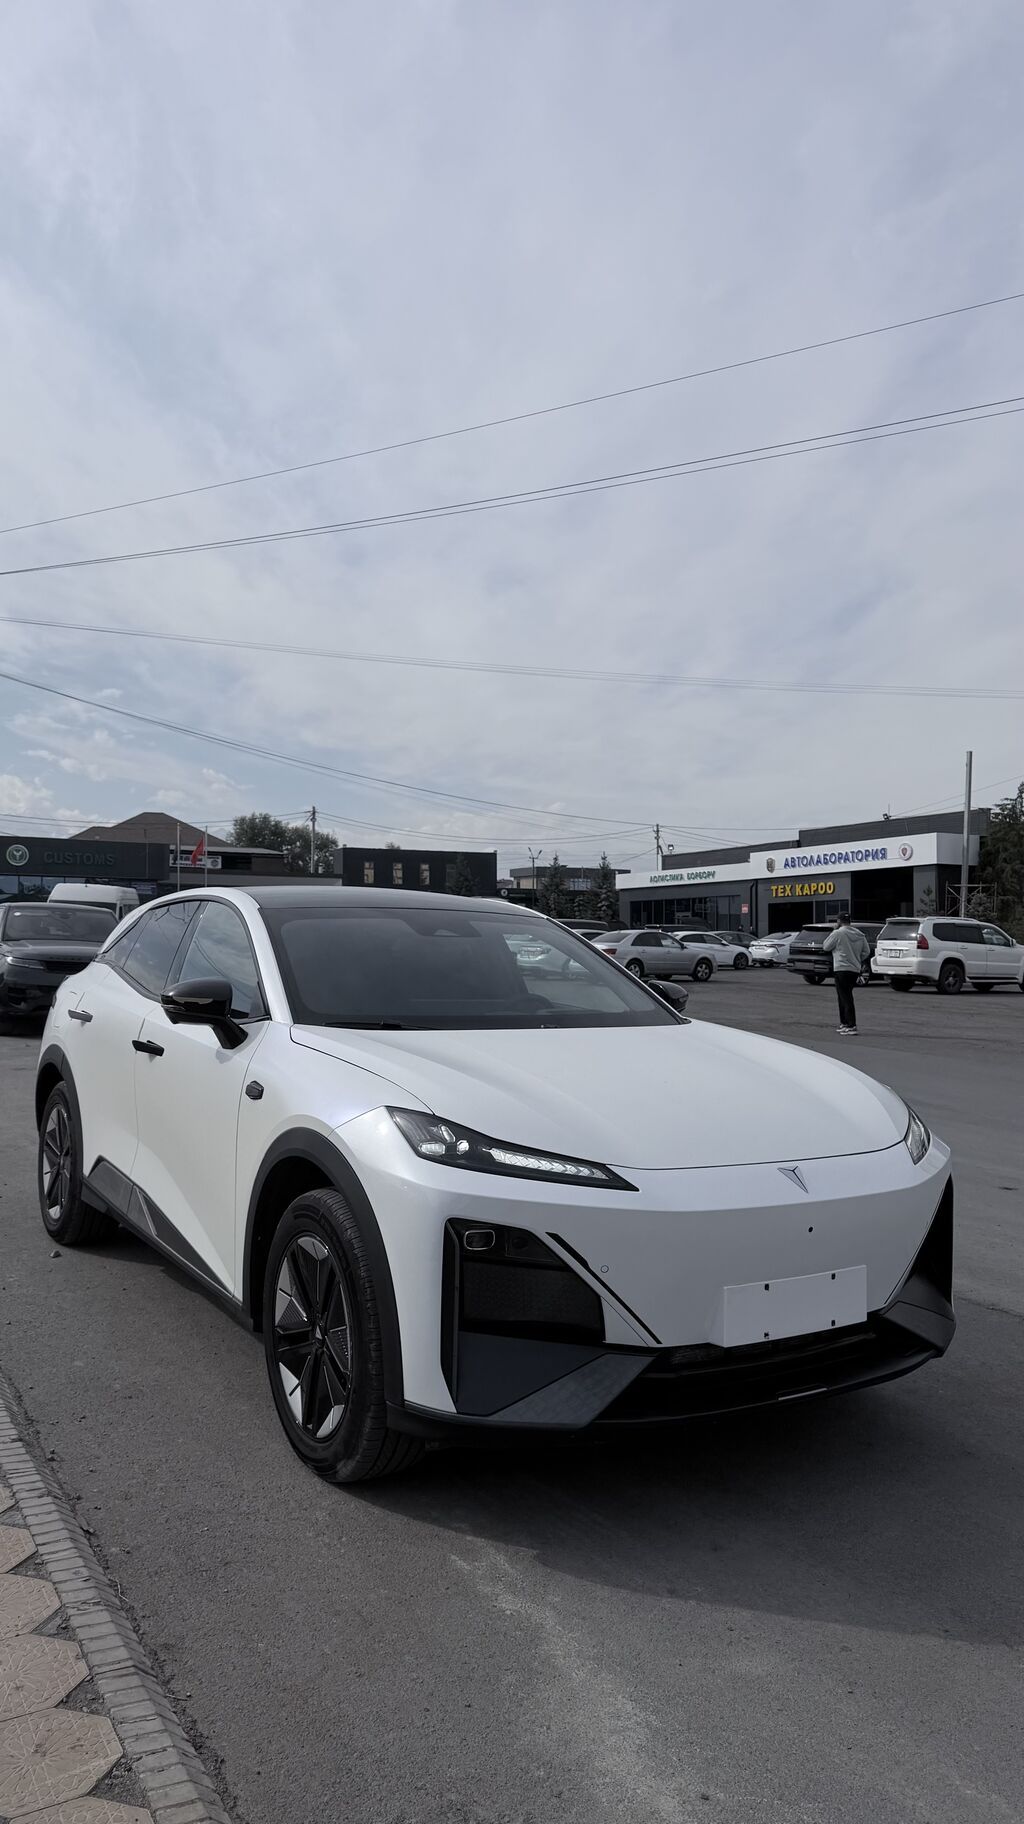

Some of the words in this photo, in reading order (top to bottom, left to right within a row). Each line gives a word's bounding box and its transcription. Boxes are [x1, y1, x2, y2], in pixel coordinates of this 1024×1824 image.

[43, 851, 116, 865] CUSTOMS
[783, 847, 888, 869] АВТОЛАБОРАТОРИЯ
[770, 884, 792, 897] ТЕХ
[795, 881, 835, 896] КАРОО
